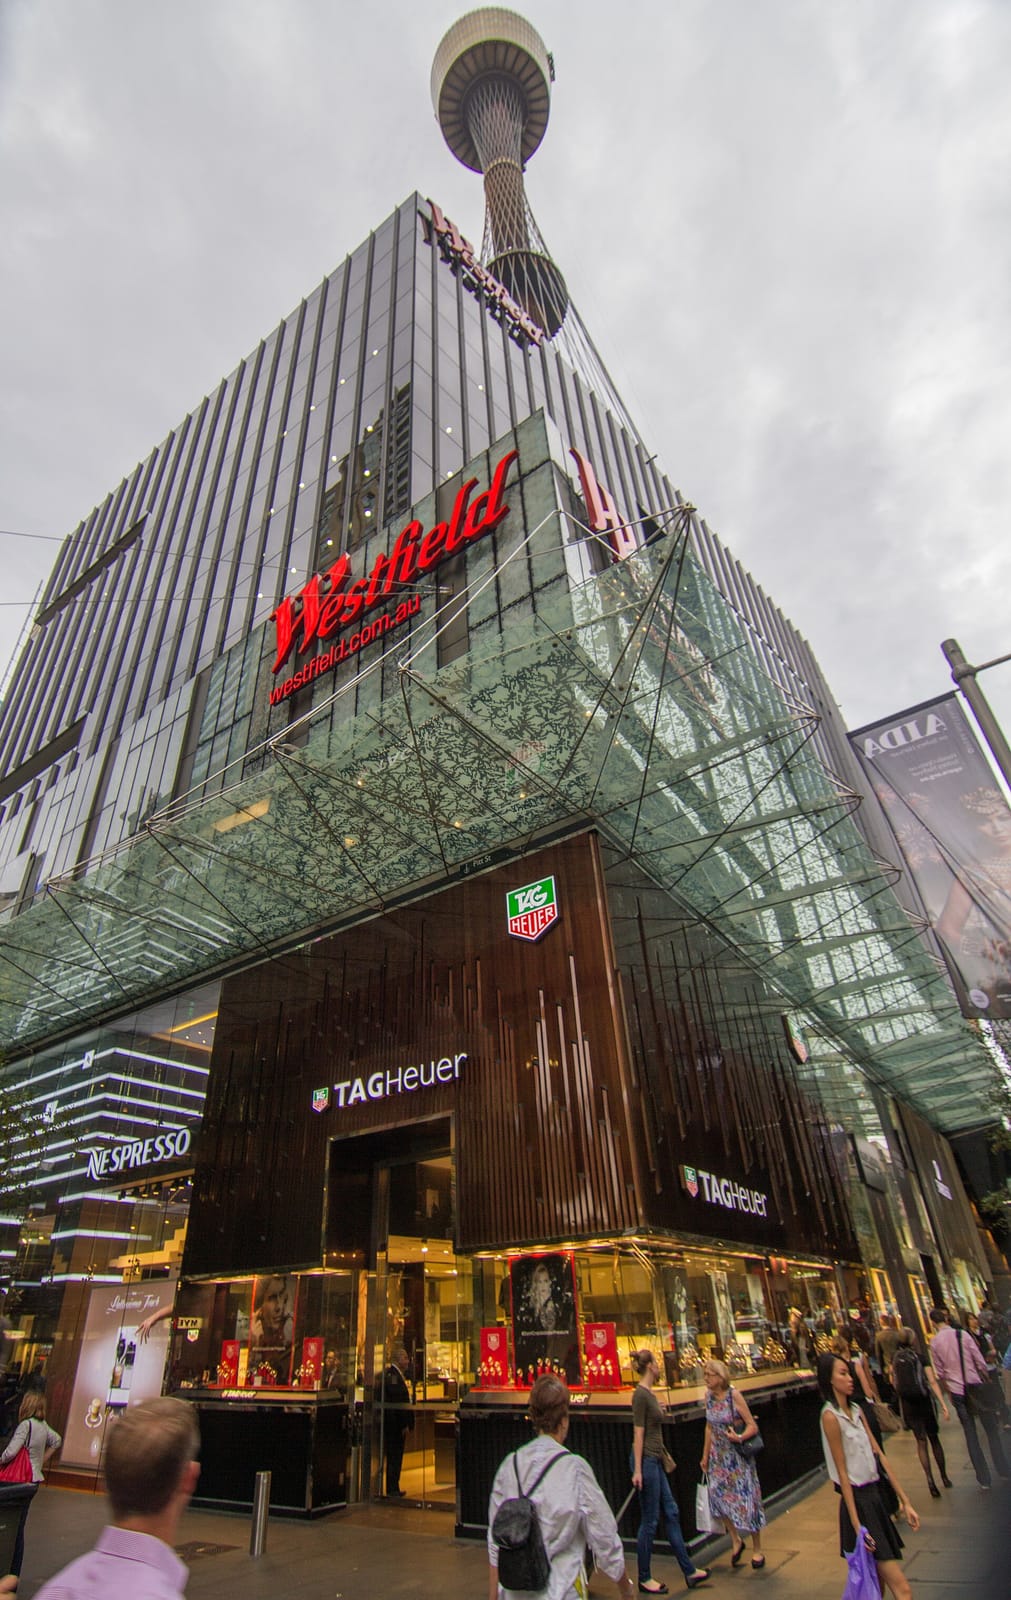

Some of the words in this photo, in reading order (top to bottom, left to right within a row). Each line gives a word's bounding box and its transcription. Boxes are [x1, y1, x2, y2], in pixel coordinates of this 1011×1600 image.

[269, 449, 519, 674] Westfield
[269, 594, 421, 706] westfield.com.au
[511, 906, 554, 936] HEUER
[514, 885, 548, 913] TAG
[86, 1128, 191, 1181] NESPRESSO
